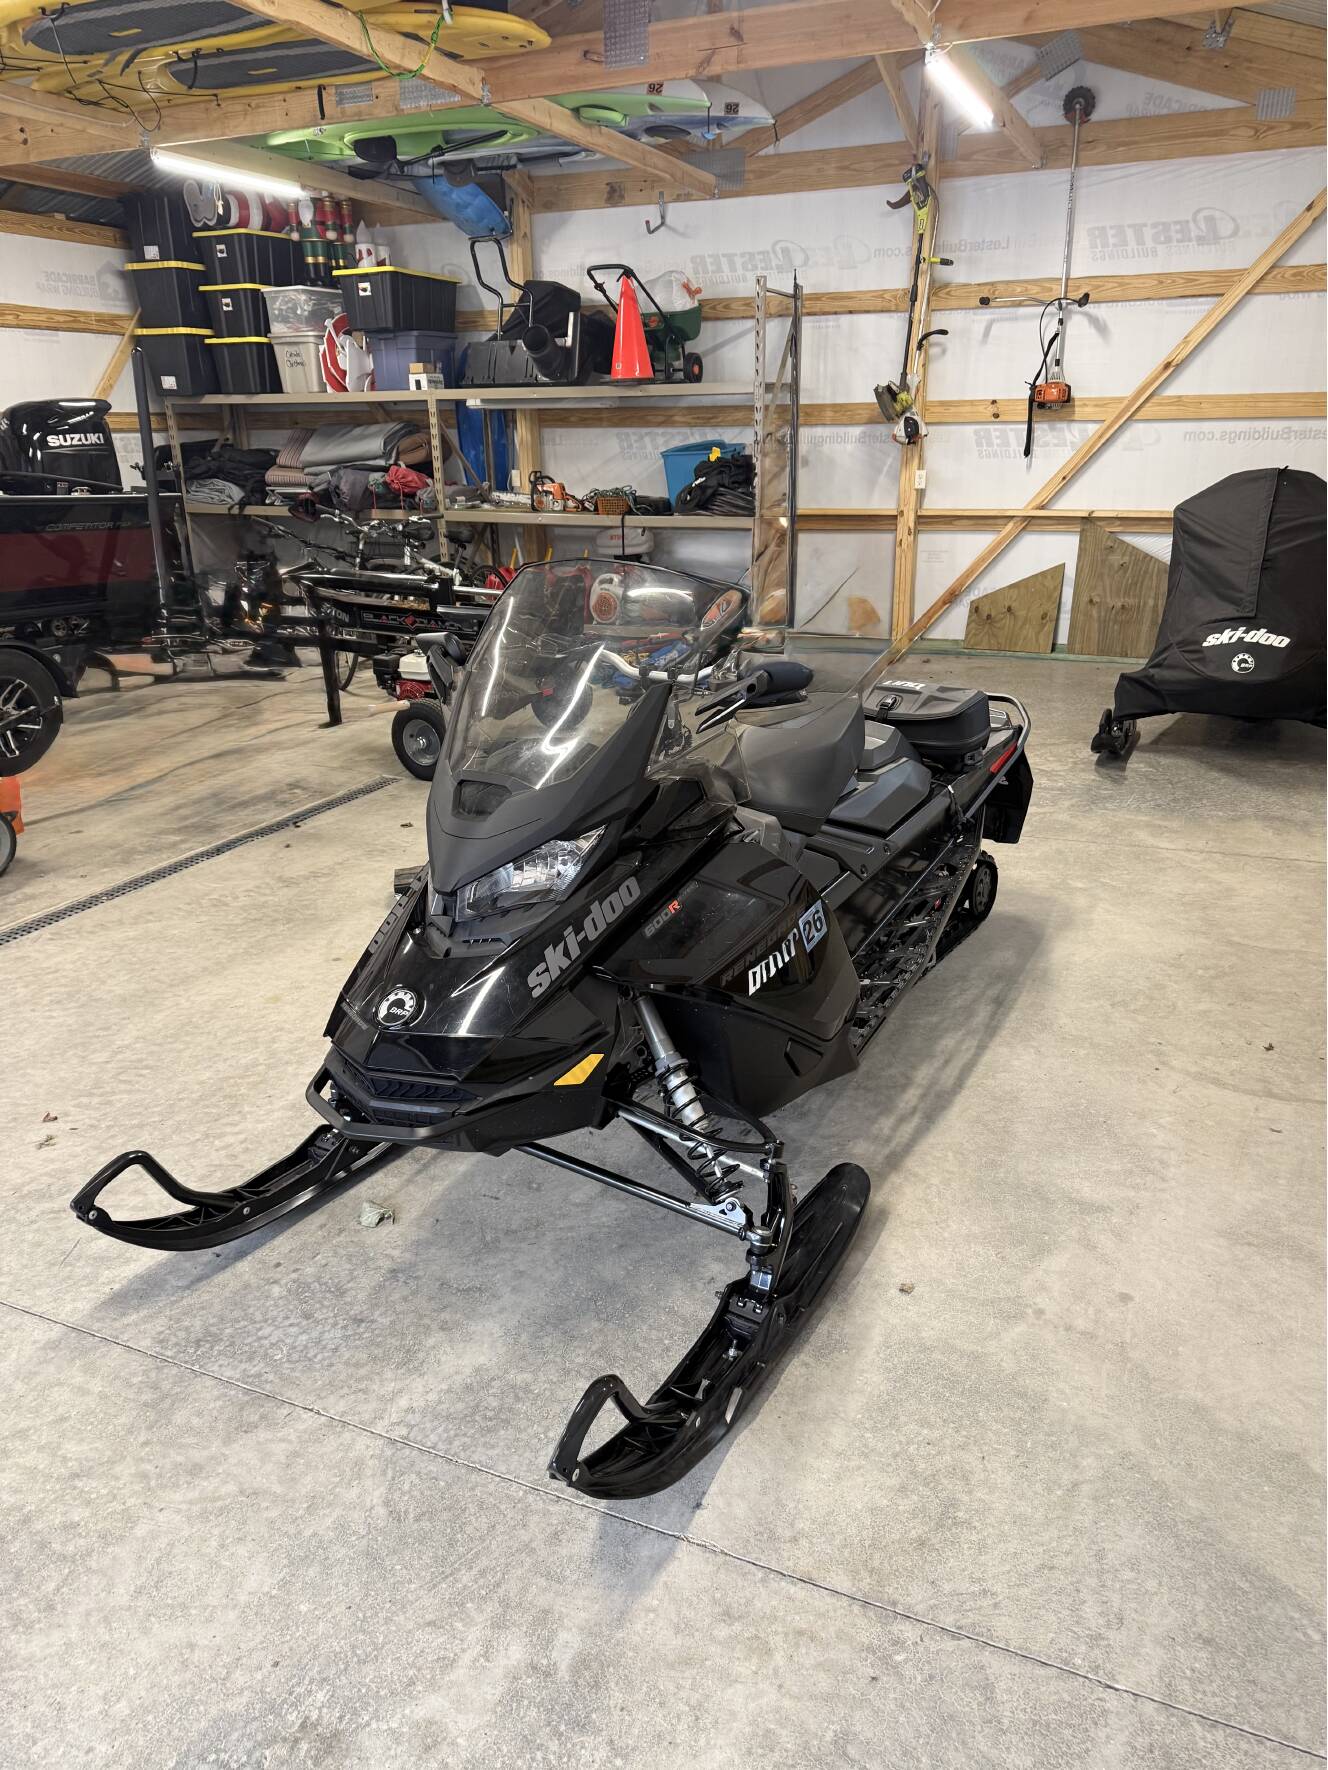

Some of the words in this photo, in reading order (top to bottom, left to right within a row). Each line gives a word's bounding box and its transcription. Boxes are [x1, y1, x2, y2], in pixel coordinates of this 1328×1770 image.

[46, 433, 104, 447] SUZUKI
[1201, 626, 1291, 648] ski-doo
[527, 876, 641, 999] ski-doo
[802, 909, 824, 944] 26
[388, 1006, 409, 1017] BRP
